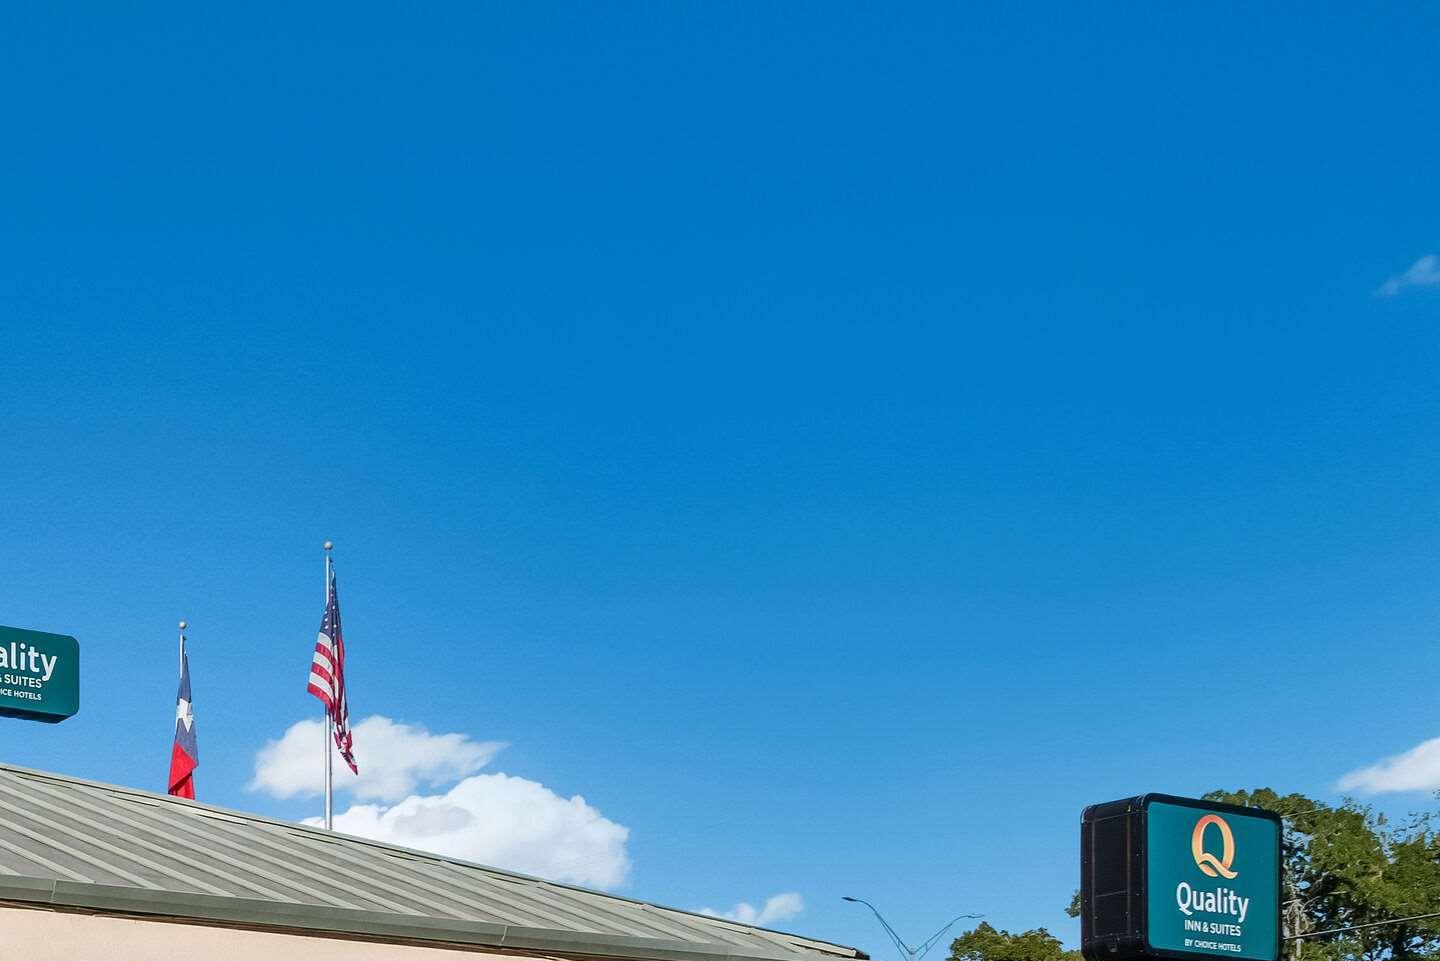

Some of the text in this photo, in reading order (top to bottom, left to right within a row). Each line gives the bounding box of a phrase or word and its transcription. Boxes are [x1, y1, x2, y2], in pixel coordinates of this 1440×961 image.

[4, 673, 42, 689] SUITES
[13, 690, 42, 701] HOTELS
[1191, 814, 1239, 880] Q
[1176, 881, 1249, 923] Quality
[1184, 919, 1242, 937] INN & SUITES
[1184, 938, 1242, 952] BY CHOICE HOTELS
